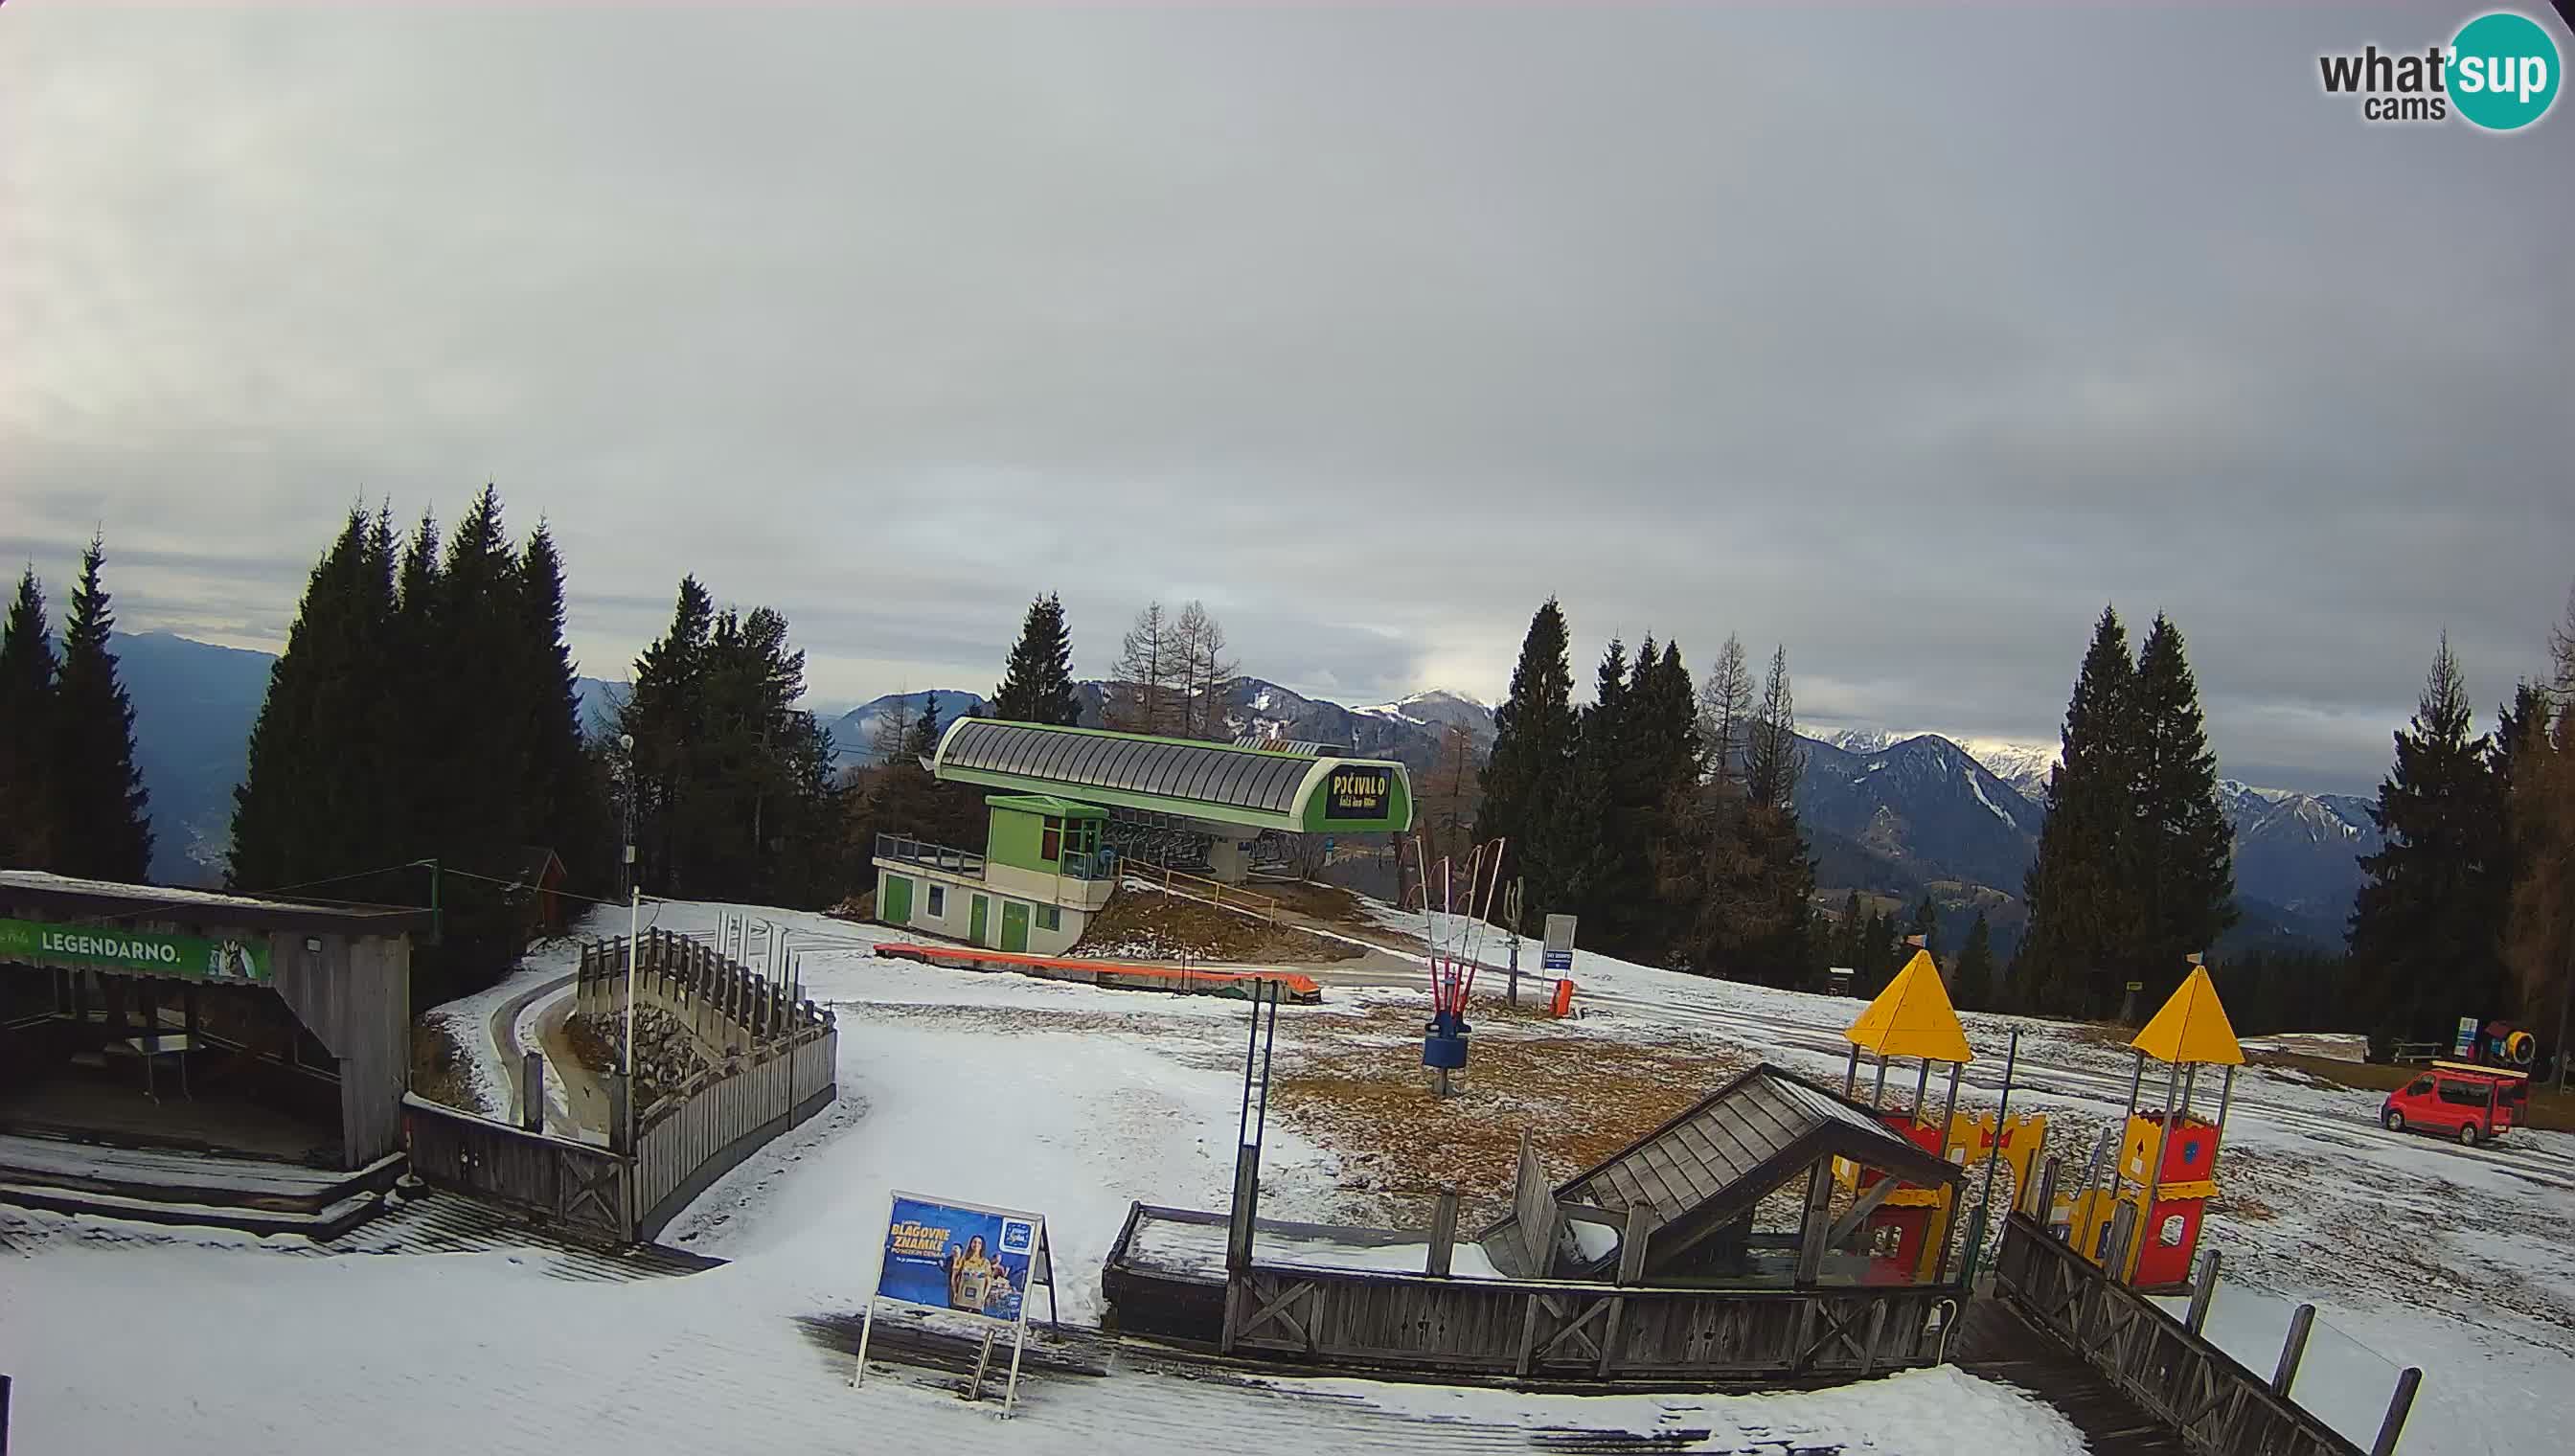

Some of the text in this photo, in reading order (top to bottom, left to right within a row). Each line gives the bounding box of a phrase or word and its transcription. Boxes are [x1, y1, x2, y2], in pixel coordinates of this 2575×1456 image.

[41, 931, 182, 964] LEGENDARNO.
[890, 1223, 950, 1241] BLAGOVNE
[893, 1235, 945, 1252] ZNAMKE
